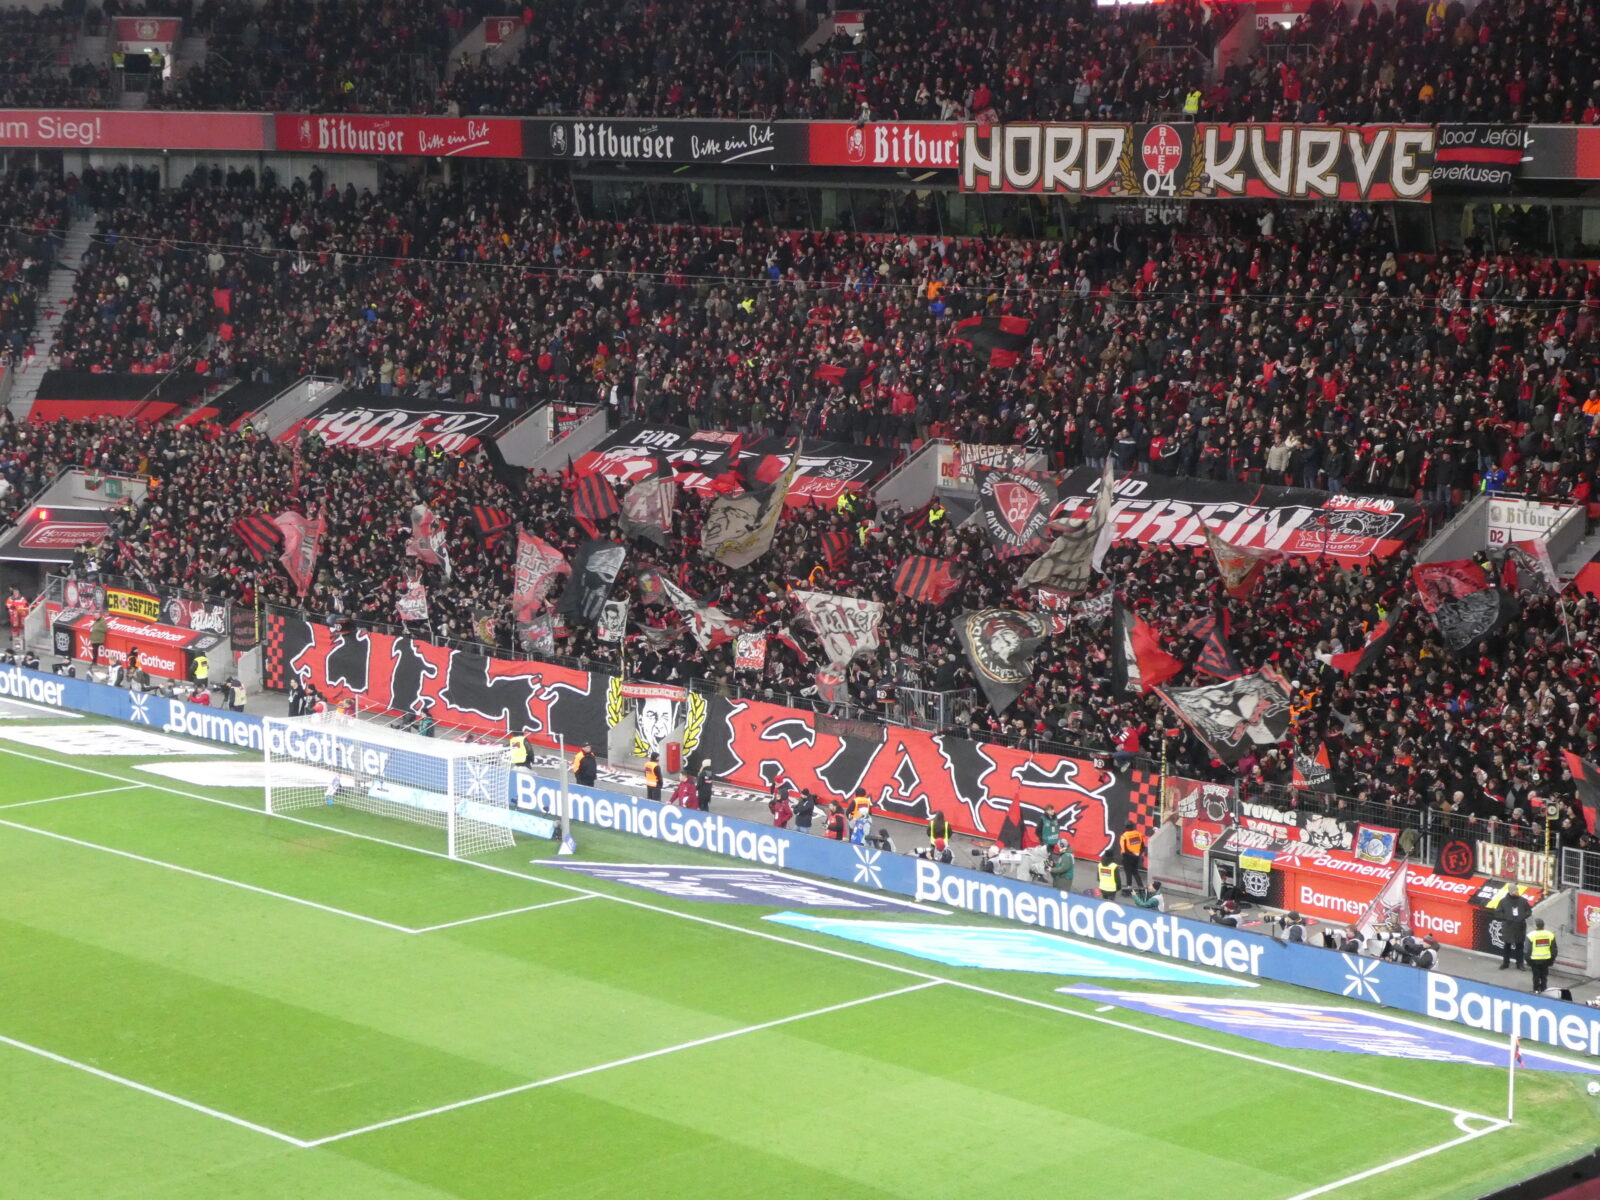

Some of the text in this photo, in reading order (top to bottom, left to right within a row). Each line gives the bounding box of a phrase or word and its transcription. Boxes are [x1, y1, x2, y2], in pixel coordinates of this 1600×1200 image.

[37, 116, 101, 145] Sieg!
[318, 117, 405, 152] Bitburger
[419, 130, 445, 152] Bitte
[447, 134, 468, 145] ein
[573, 122, 675, 159] Bitburger
[691, 135, 721, 159] Bitte
[724, 137, 748, 150] ein
[873, 125, 959, 164] Bitbur
[1439, 128, 1477, 146] Jood
[963, 124, 1435, 198] NORD KURVE
[1143, 145, 1180, 156] BAYER
[1158, 127, 1167, 173] BAYER
[1143, 168, 1177, 197] 04
[629, 429, 681, 448] FÜR
[1489, 529, 1504, 543] D2
[1241, 801, 1297, 826] YOUNG
[1477, 841, 1556, 887] LEV ELITE
[915, 859, 1264, 976] BarmeniaGothaer
